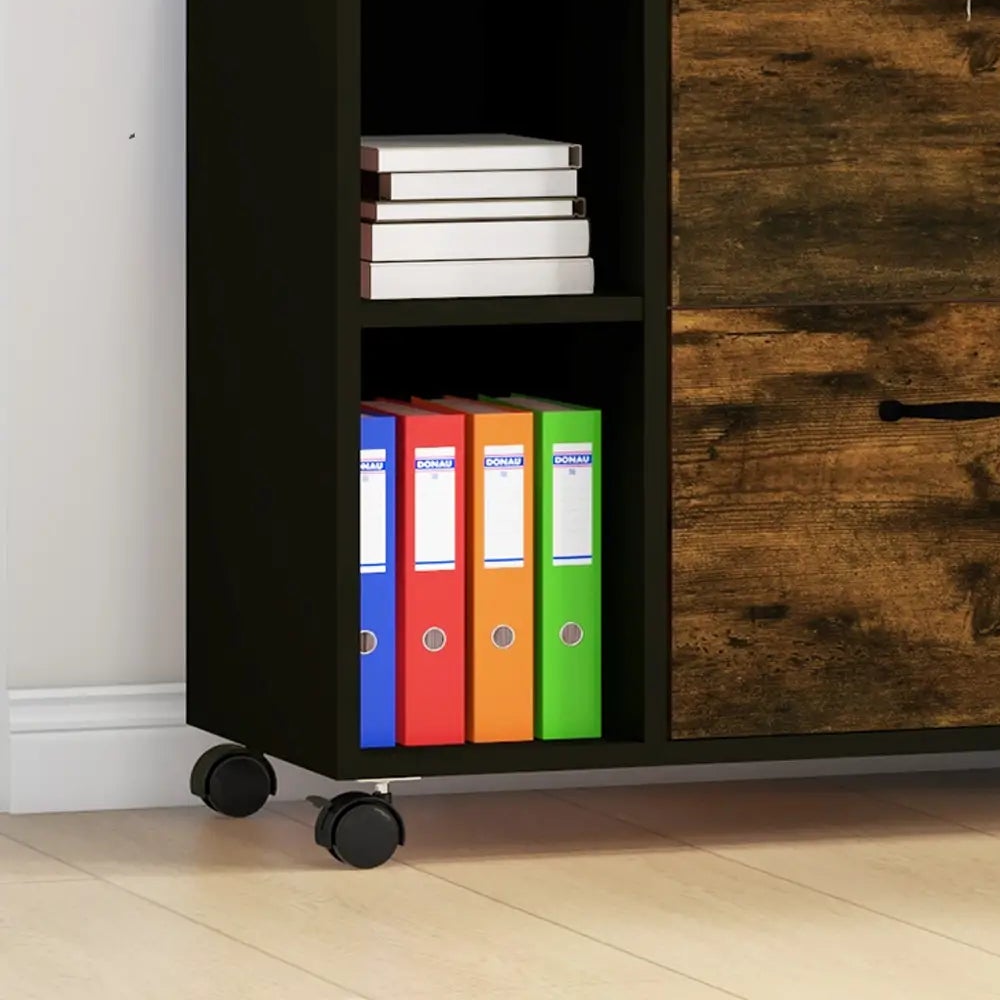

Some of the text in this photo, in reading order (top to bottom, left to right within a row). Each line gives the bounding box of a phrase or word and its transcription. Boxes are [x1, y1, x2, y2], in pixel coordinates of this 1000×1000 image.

[416, 459, 453, 469] DONAU
[486, 456, 522, 467] DONAU
[554, 455, 590, 465] DONAU
